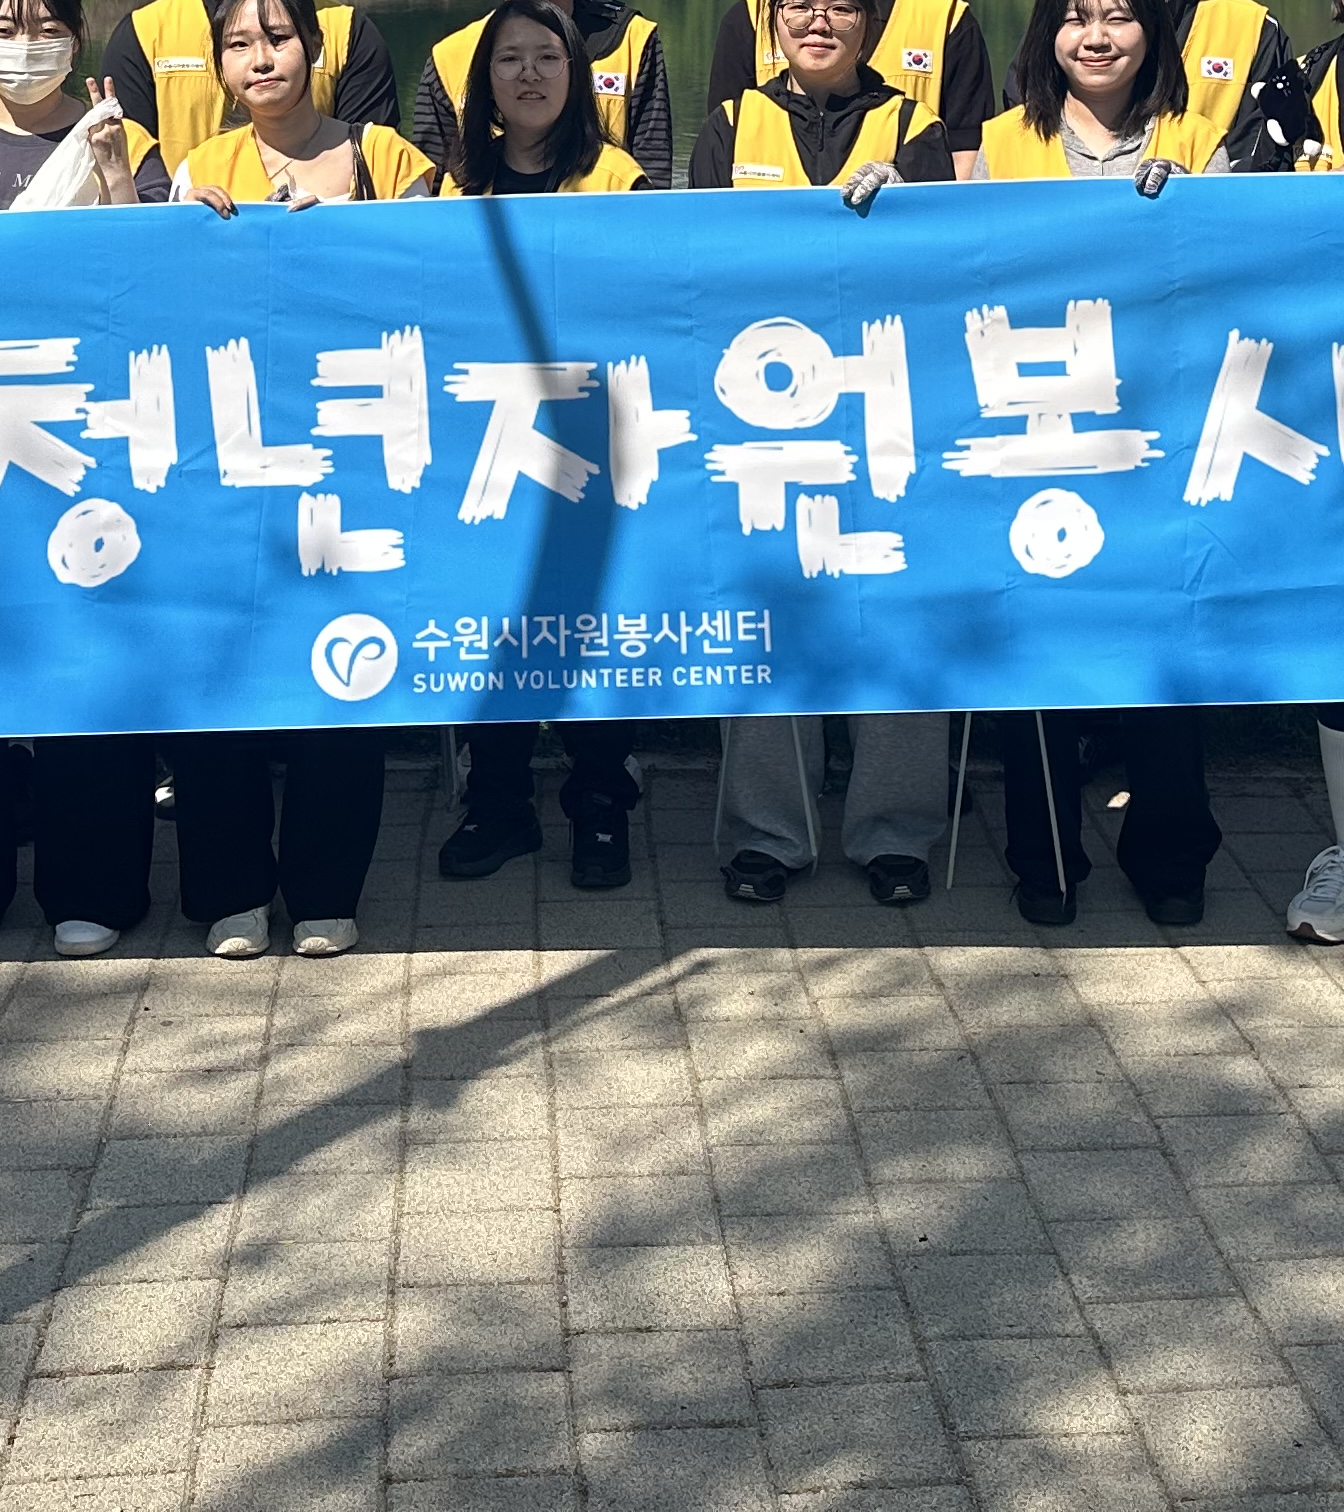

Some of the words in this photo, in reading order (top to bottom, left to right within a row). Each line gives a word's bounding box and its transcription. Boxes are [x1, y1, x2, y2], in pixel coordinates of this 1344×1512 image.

[413, 609, 773, 662] 수원시자원봉사센터
[413, 672, 504, 694] SUWON
[515, 668, 663, 691] VOLUNTEER
[672, 665, 773, 687] CENTER
